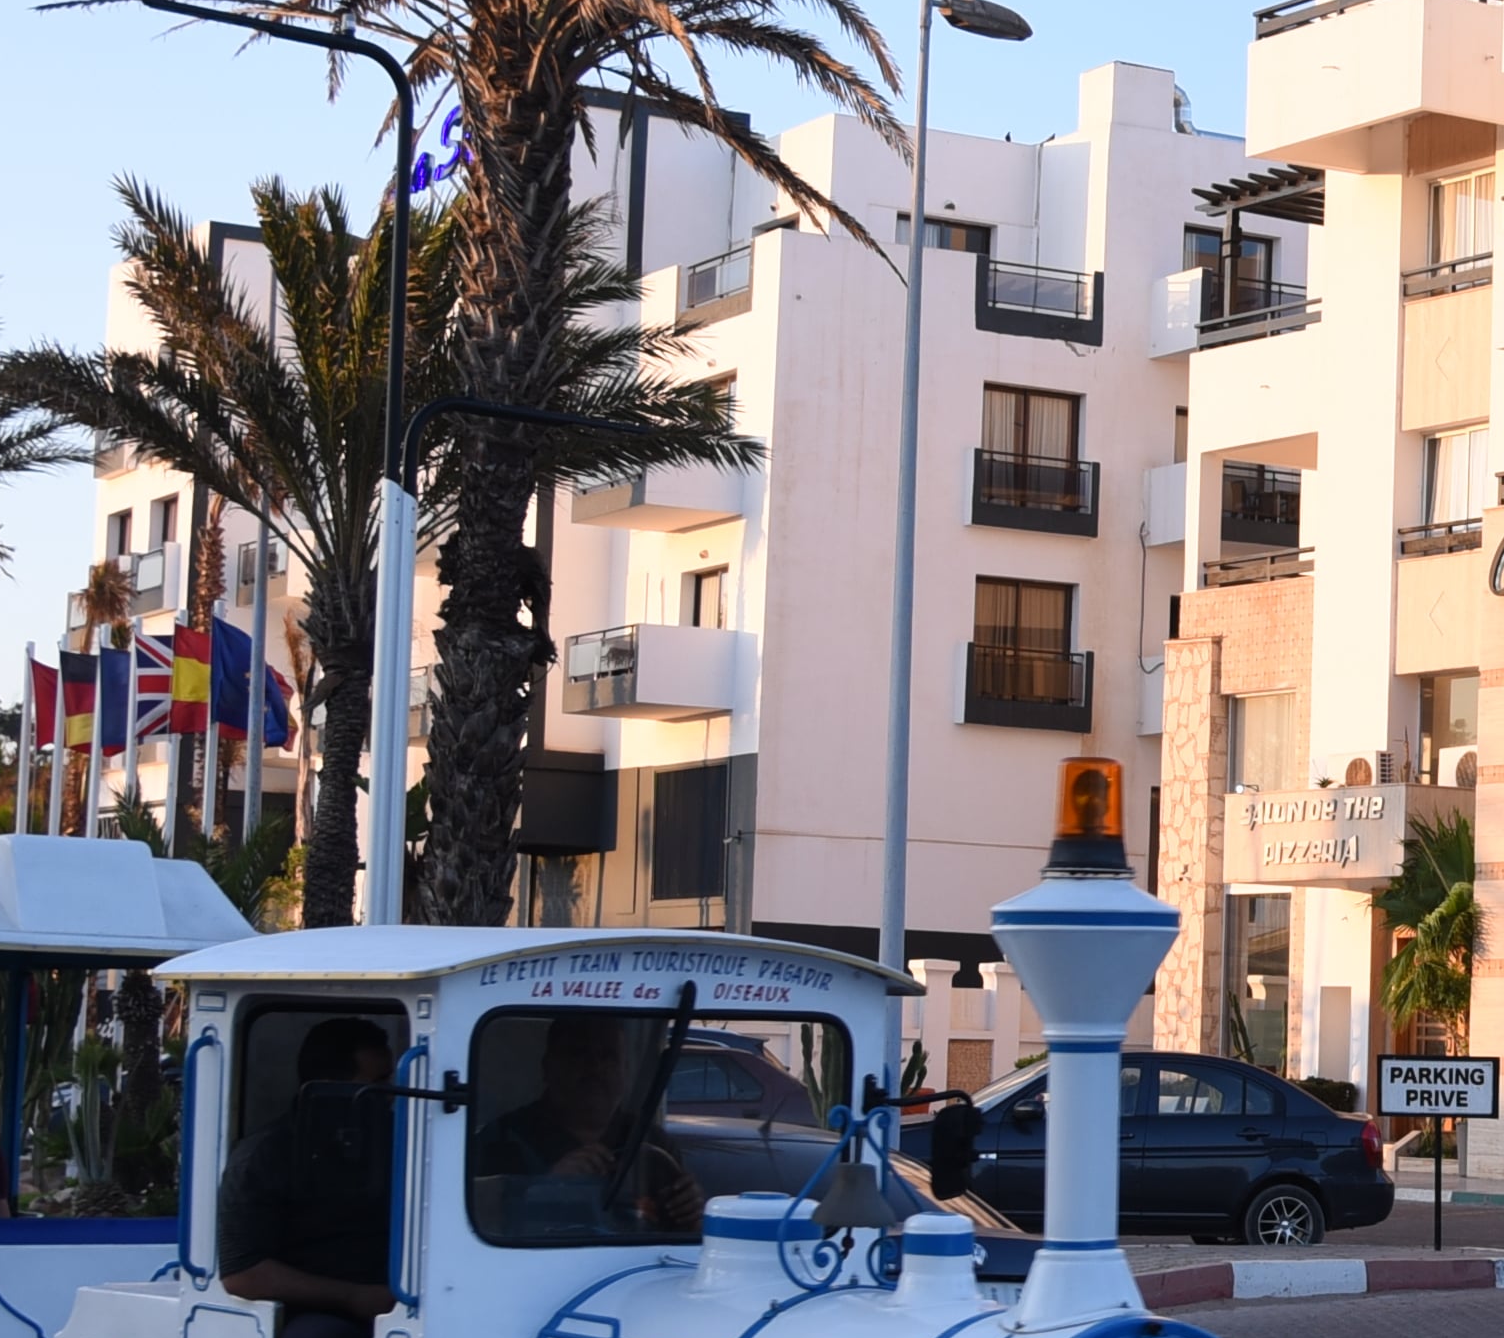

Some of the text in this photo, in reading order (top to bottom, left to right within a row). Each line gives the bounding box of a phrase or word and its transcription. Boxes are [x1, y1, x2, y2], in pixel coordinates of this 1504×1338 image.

[480, 951, 834, 991] LE PETIT TRAIN TOURISTIQUE D'AGADIR
[531, 981, 792, 1003] LA VALLEE des OISEAUX
[1390, 1067, 1485, 1086] PARKING
[1405, 1090, 1469, 1108] PRIVE
